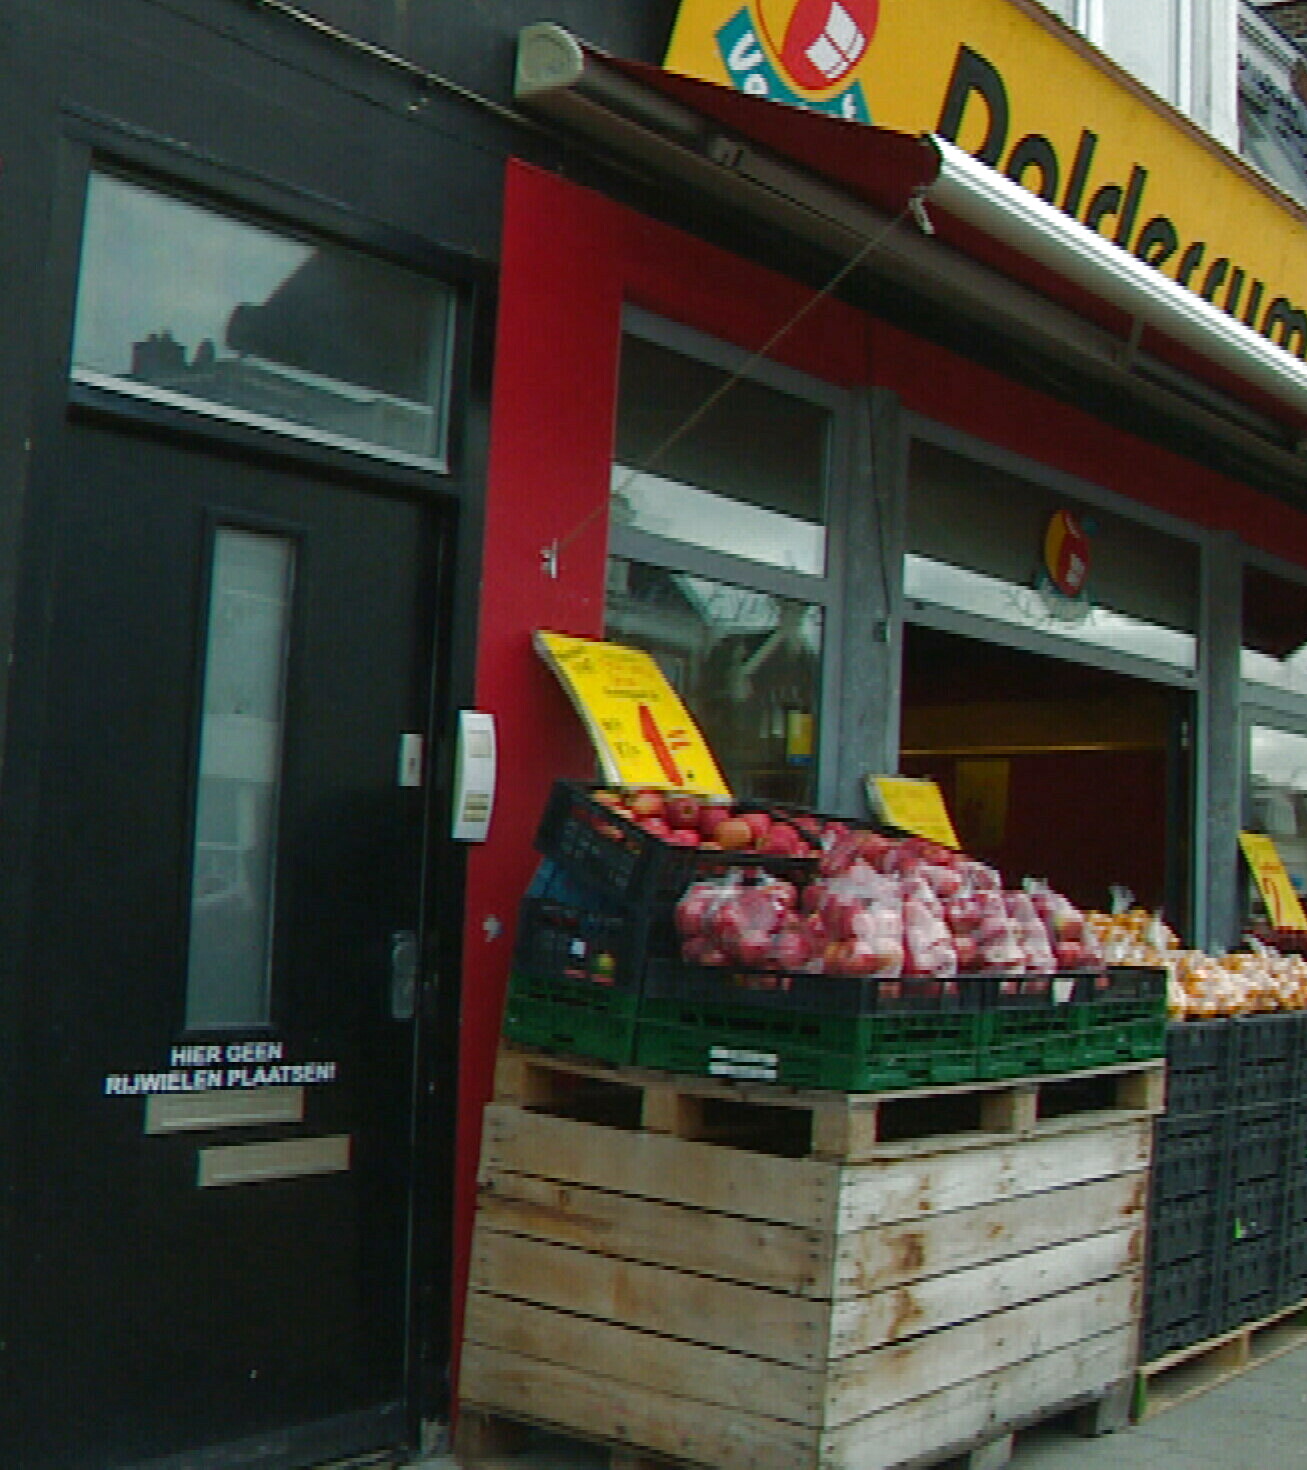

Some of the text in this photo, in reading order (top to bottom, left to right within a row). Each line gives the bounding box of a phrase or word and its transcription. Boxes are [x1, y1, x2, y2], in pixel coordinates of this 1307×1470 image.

[170, 1041, 284, 1067] HIER GEEN
[105, 1061, 337, 1095] RIJWIELEN PLAATSEN!
